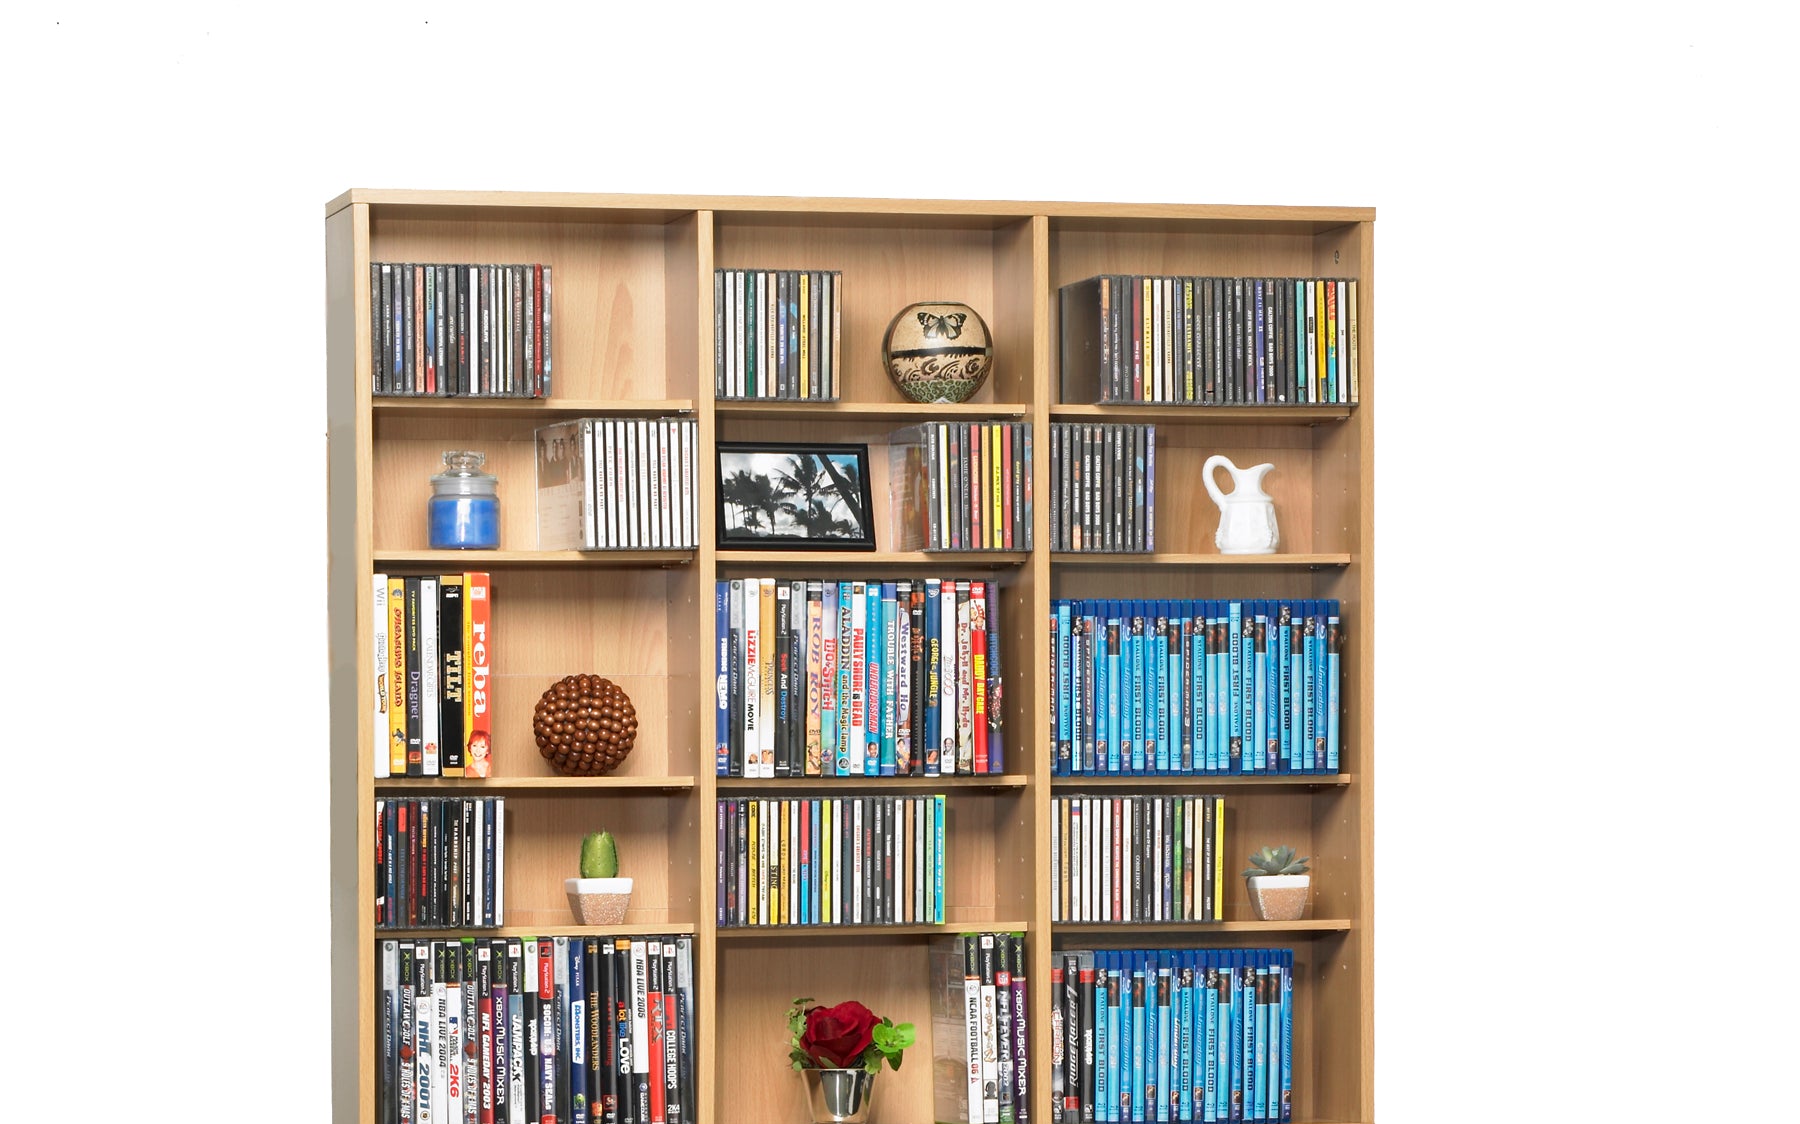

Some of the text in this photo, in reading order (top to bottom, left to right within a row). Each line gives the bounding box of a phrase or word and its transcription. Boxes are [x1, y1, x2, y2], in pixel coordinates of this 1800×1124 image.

[960, 623, 968, 636] Dr.
[961, 639, 969, 666] Jekyll
[447, 651, 462, 702] TILT
[472, 621, 489, 717] reba
[780, 653, 788, 671] Seek
[839, 607, 850, 752] ALADDIN and the Magic lamp
[885, 621, 895, 738] TROUBLE WITH FATHER
[900, 622, 909, 711] Westward Ho
[929, 671, 937, 698] JUNGLE
[974, 654, 984, 714] DADDY DAY CARE
[410, 671, 420, 719] Dragnet
[779, 691, 788, 720] Destroy
[868, 662, 878, 733] UNDERCLASSMAN
[962, 706, 970, 728] Hyde
[636, 959, 644, 974] NBA
[438, 999, 446, 1013] NBA
[543, 1004, 551, 1036] SOCOM:
[590, 992, 600, 1070] THE WOODLANDERS
[482, 1013, 491, 1109] NFL GAMEDAY 2003
[666, 1030, 677, 1089] COLLEGE HOOPS
[970, 997, 979, 1074] NCAA FOOTBALL 06
[419, 1020, 430, 1109] NHL 2001
